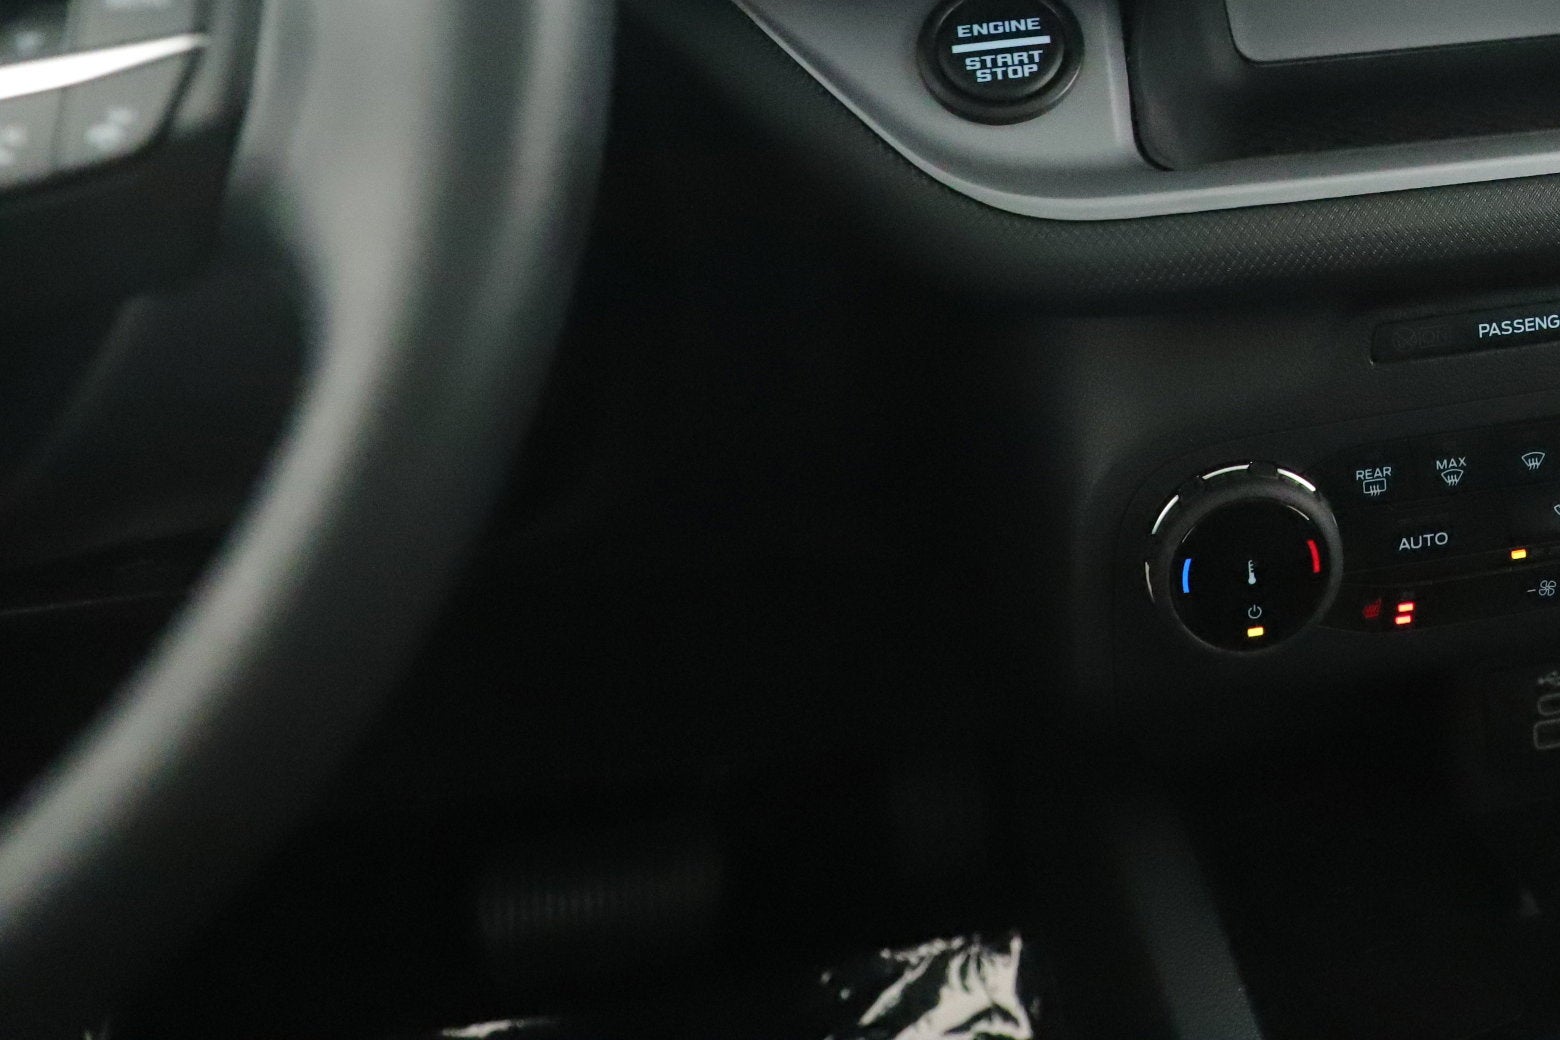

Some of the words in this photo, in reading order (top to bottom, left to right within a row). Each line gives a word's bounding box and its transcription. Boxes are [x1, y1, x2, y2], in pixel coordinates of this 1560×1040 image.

[957, 17, 1042, 38] ENGINE
[965, 49, 1044, 71] START
[975, 63, 1039, 83] STOP
[1356, 466, 1392, 481] REAR
[1436, 456, 1467, 471] MAX
[1398, 531, 1449, 552] AUTO
